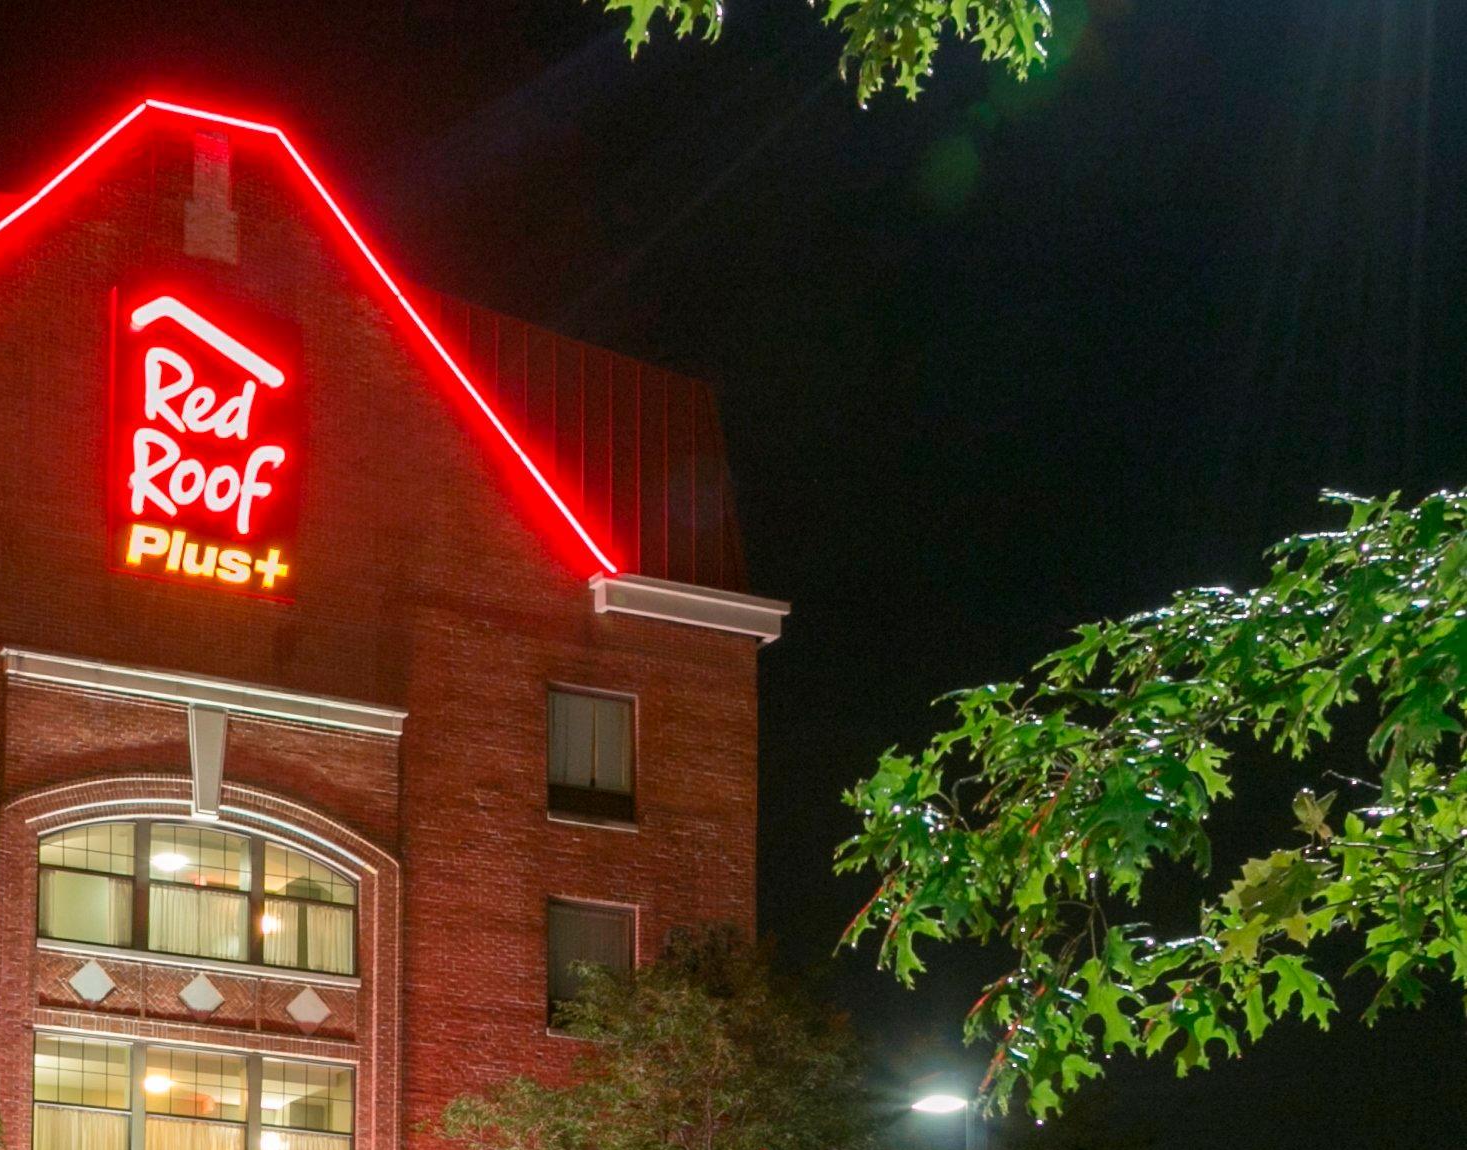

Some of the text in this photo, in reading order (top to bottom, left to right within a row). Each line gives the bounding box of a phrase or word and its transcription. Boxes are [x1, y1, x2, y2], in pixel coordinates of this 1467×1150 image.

[144, 346, 257, 441] Red
[129, 428, 286, 535] Roof
[126, 523, 289, 588] Plus+
